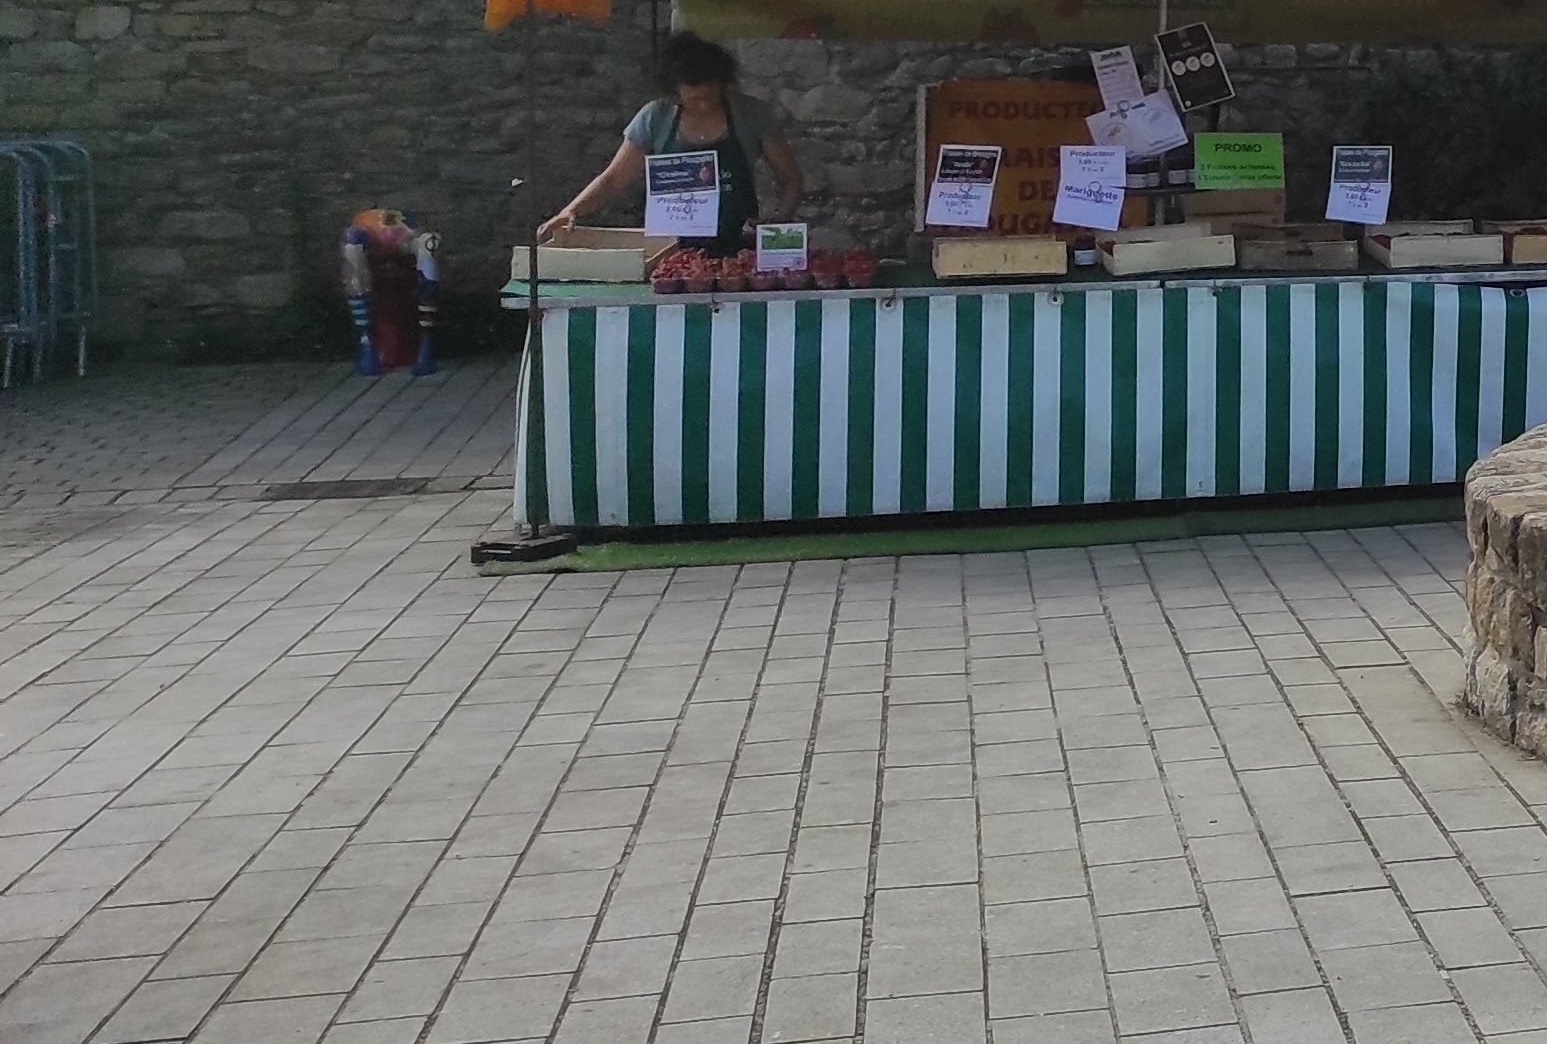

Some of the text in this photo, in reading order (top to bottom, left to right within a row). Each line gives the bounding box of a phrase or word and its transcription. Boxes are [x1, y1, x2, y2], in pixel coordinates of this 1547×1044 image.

[950, 101, 1097, 119] PRODUCTE
[1215, 143, 1262, 153] PROMO
[1018, 180, 1056, 201] DE
